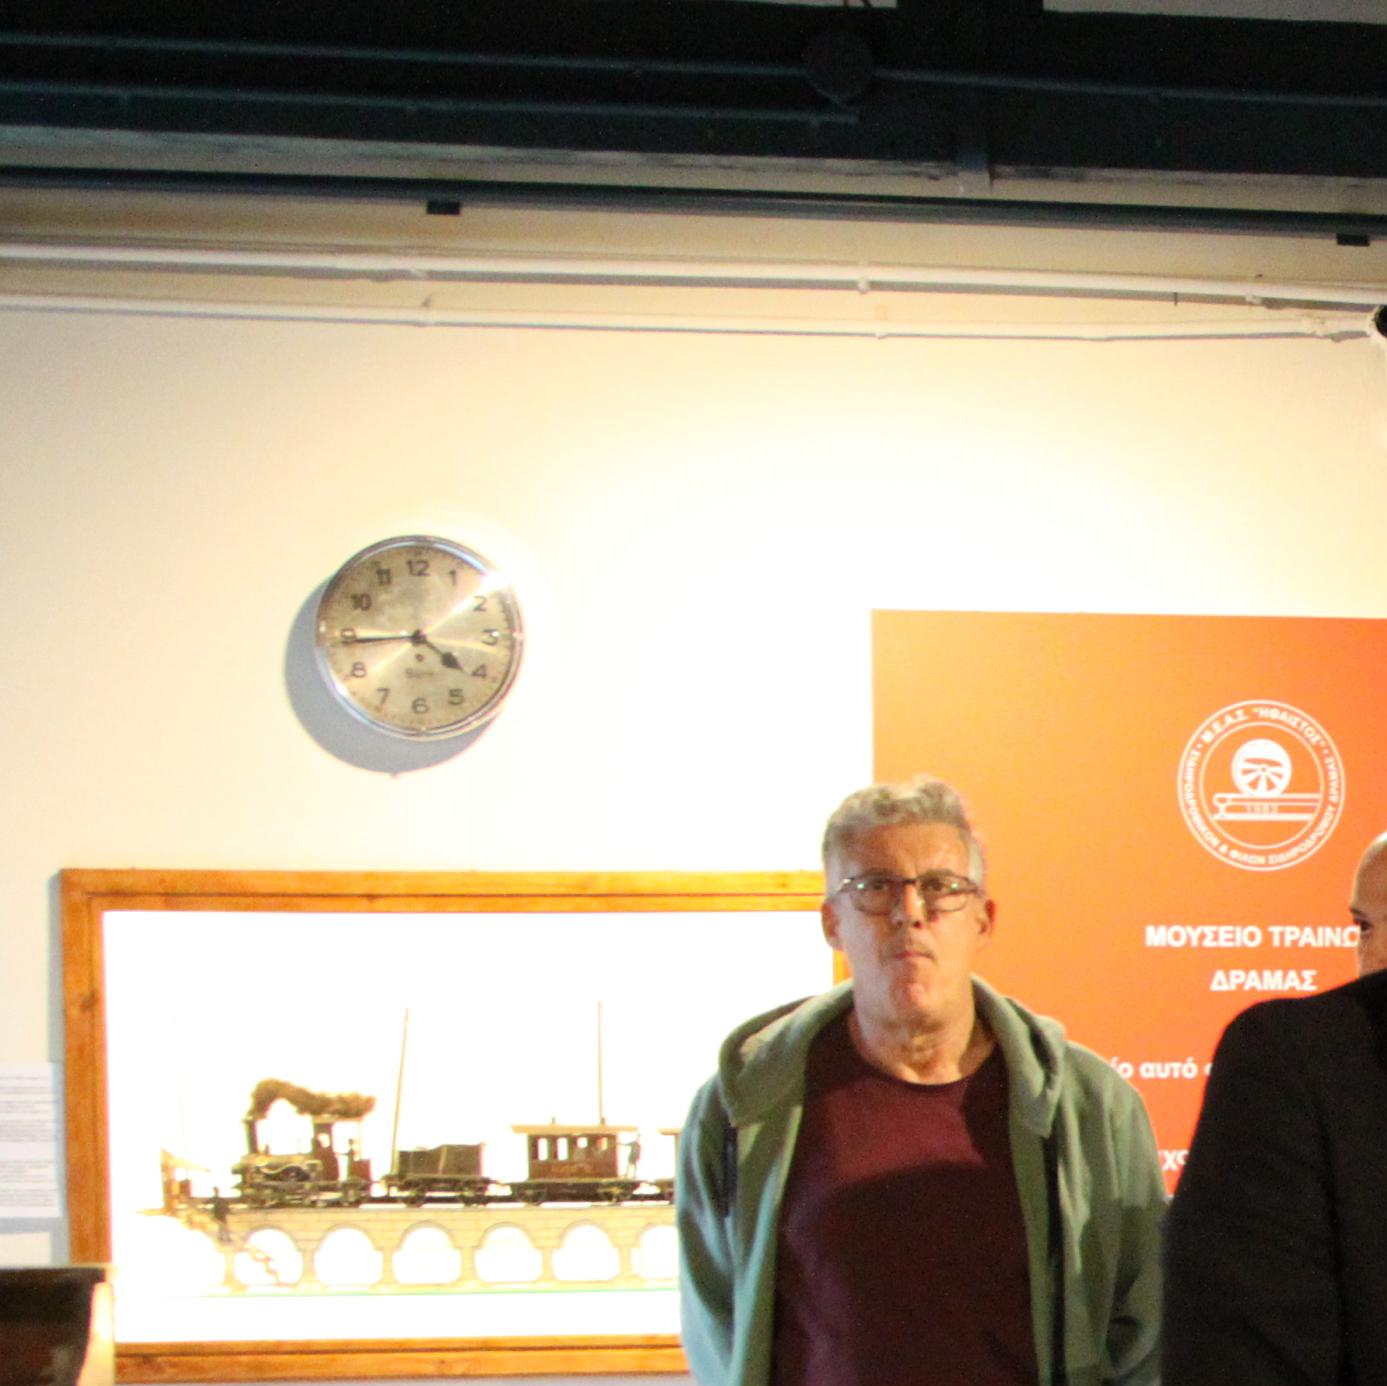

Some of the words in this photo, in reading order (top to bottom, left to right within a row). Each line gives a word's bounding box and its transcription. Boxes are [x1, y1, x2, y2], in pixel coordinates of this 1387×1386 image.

[376, 568, 391, 585] 11
[406, 560, 431, 577] 12
[449, 570, 457, 586] 1
[351, 594, 372, 611] 10
[473, 596, 487, 612] 2
[351, 661, 366, 678] 8
[472, 664, 487, 679] 4
[376, 688, 390, 704] 7
[448, 688, 464, 706] 5
[412, 698, 429, 713] 6
[1145, 925, 1262, 948] ΜΟΥΣΕΙΟ
[1210, 969, 1318, 991] ΔΡΑΜΑΣ
[1139, 1057, 1198, 1079] αυτό
